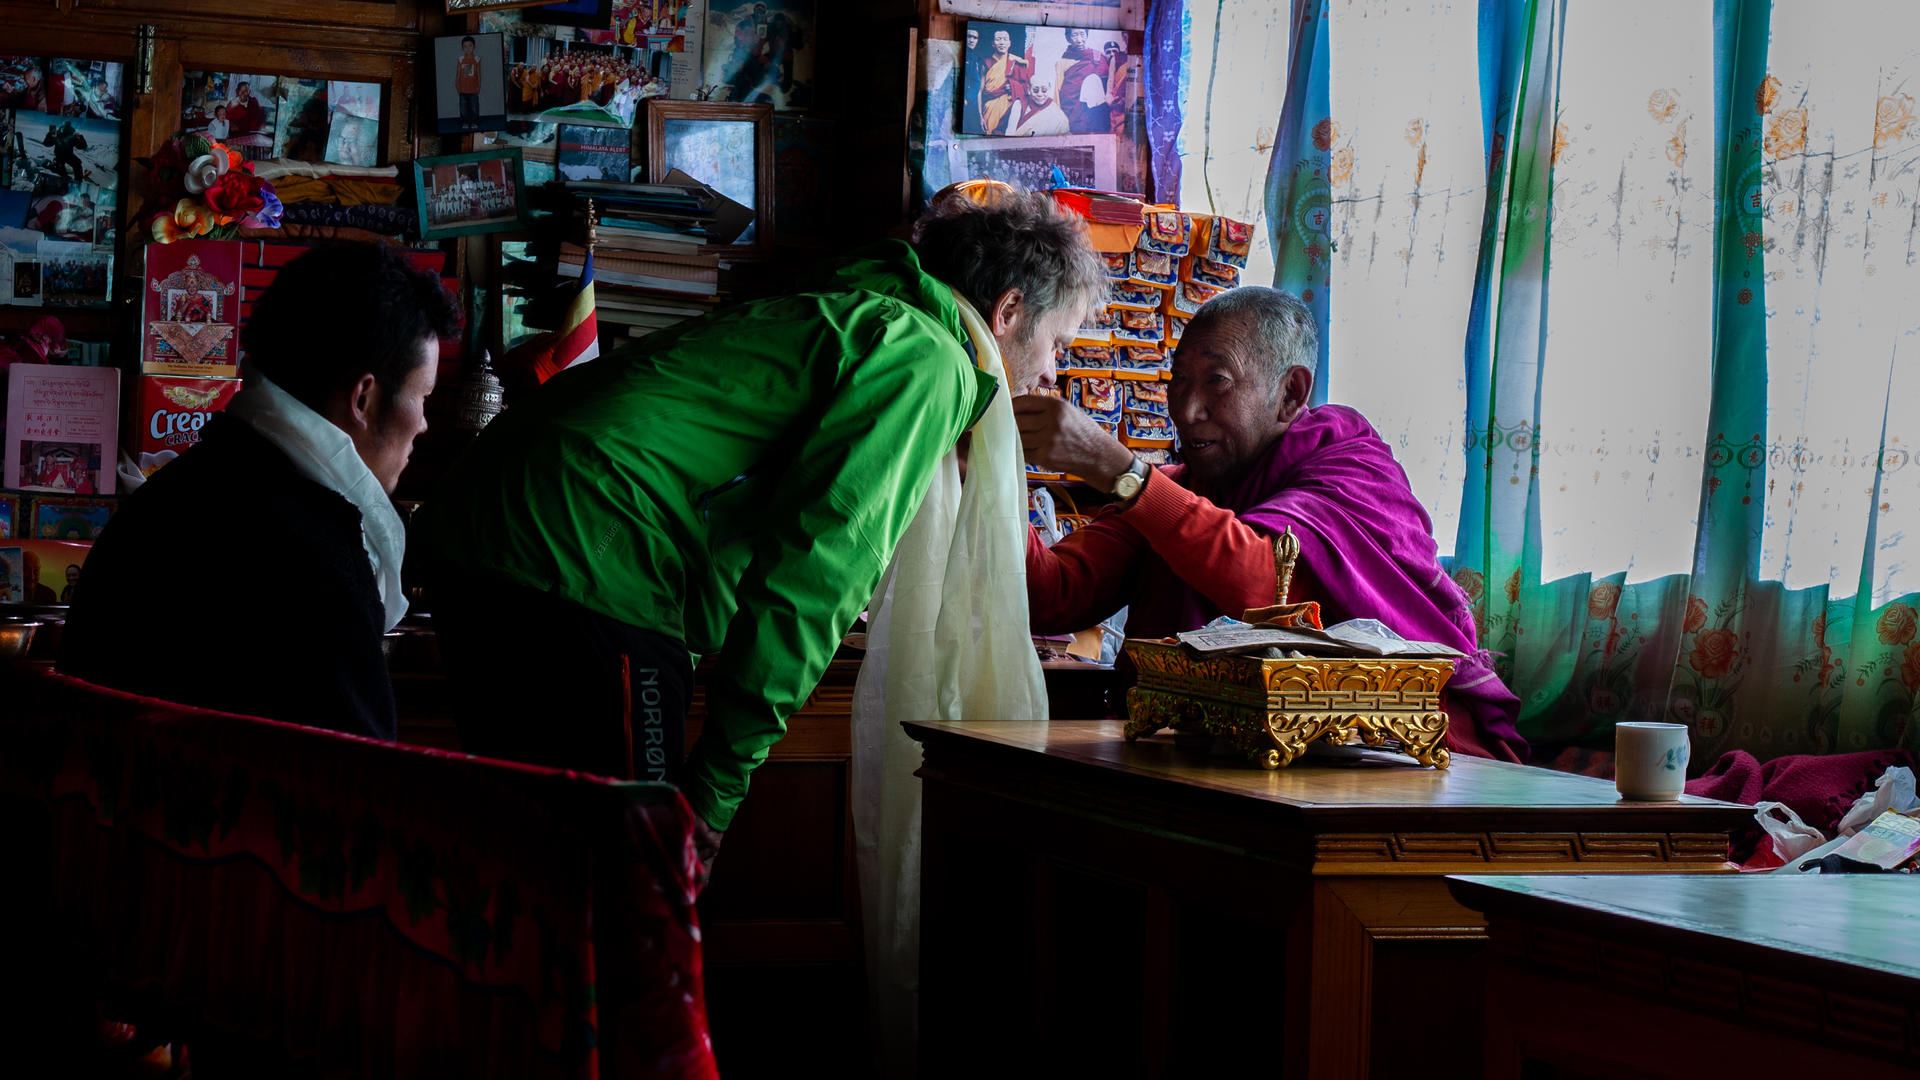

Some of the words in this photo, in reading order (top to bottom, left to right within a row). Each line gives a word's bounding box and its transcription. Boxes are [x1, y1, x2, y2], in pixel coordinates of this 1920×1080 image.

[580, 144, 609, 152] HIMALAYA
[1750, 189, 1763, 208] 吉
[1312, 209, 1325, 226] 吉
[165, 431, 202, 446] CRAC
